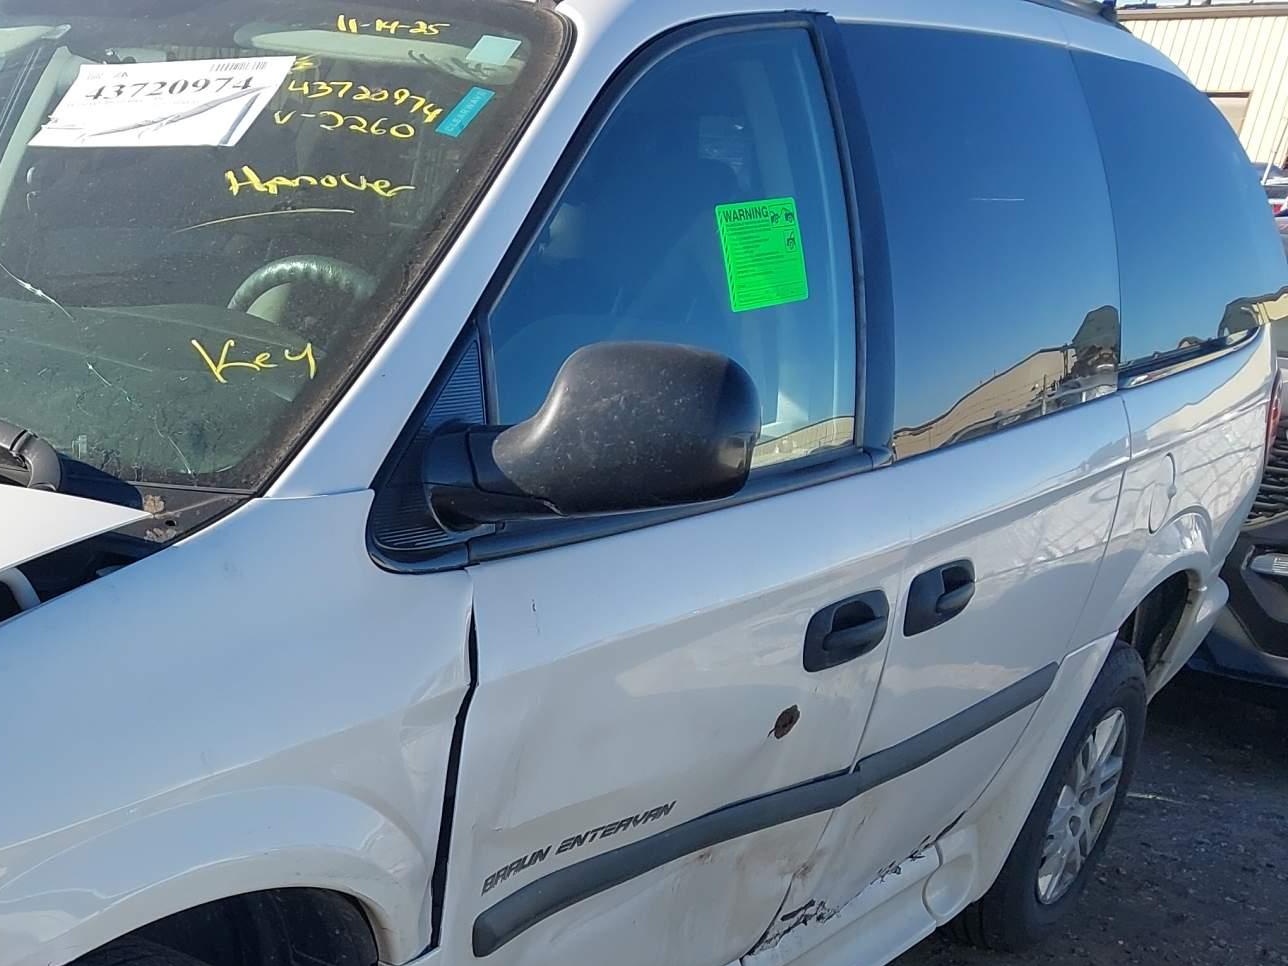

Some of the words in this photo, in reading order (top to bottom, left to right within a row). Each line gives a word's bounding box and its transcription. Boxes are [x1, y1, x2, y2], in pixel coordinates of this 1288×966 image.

[337, 15, 450, 34] 11-14-25
[85, 76, 254, 100] 43720974
[288, 80, 443, 123] 43720974
[224, 165, 416, 197] Hanover
[723, 206, 769, 222] WARNING
[191, 339, 317, 384] Key
[481, 845, 553, 897] BRAUN
[555, 800, 677, 856] ENTERVAN
